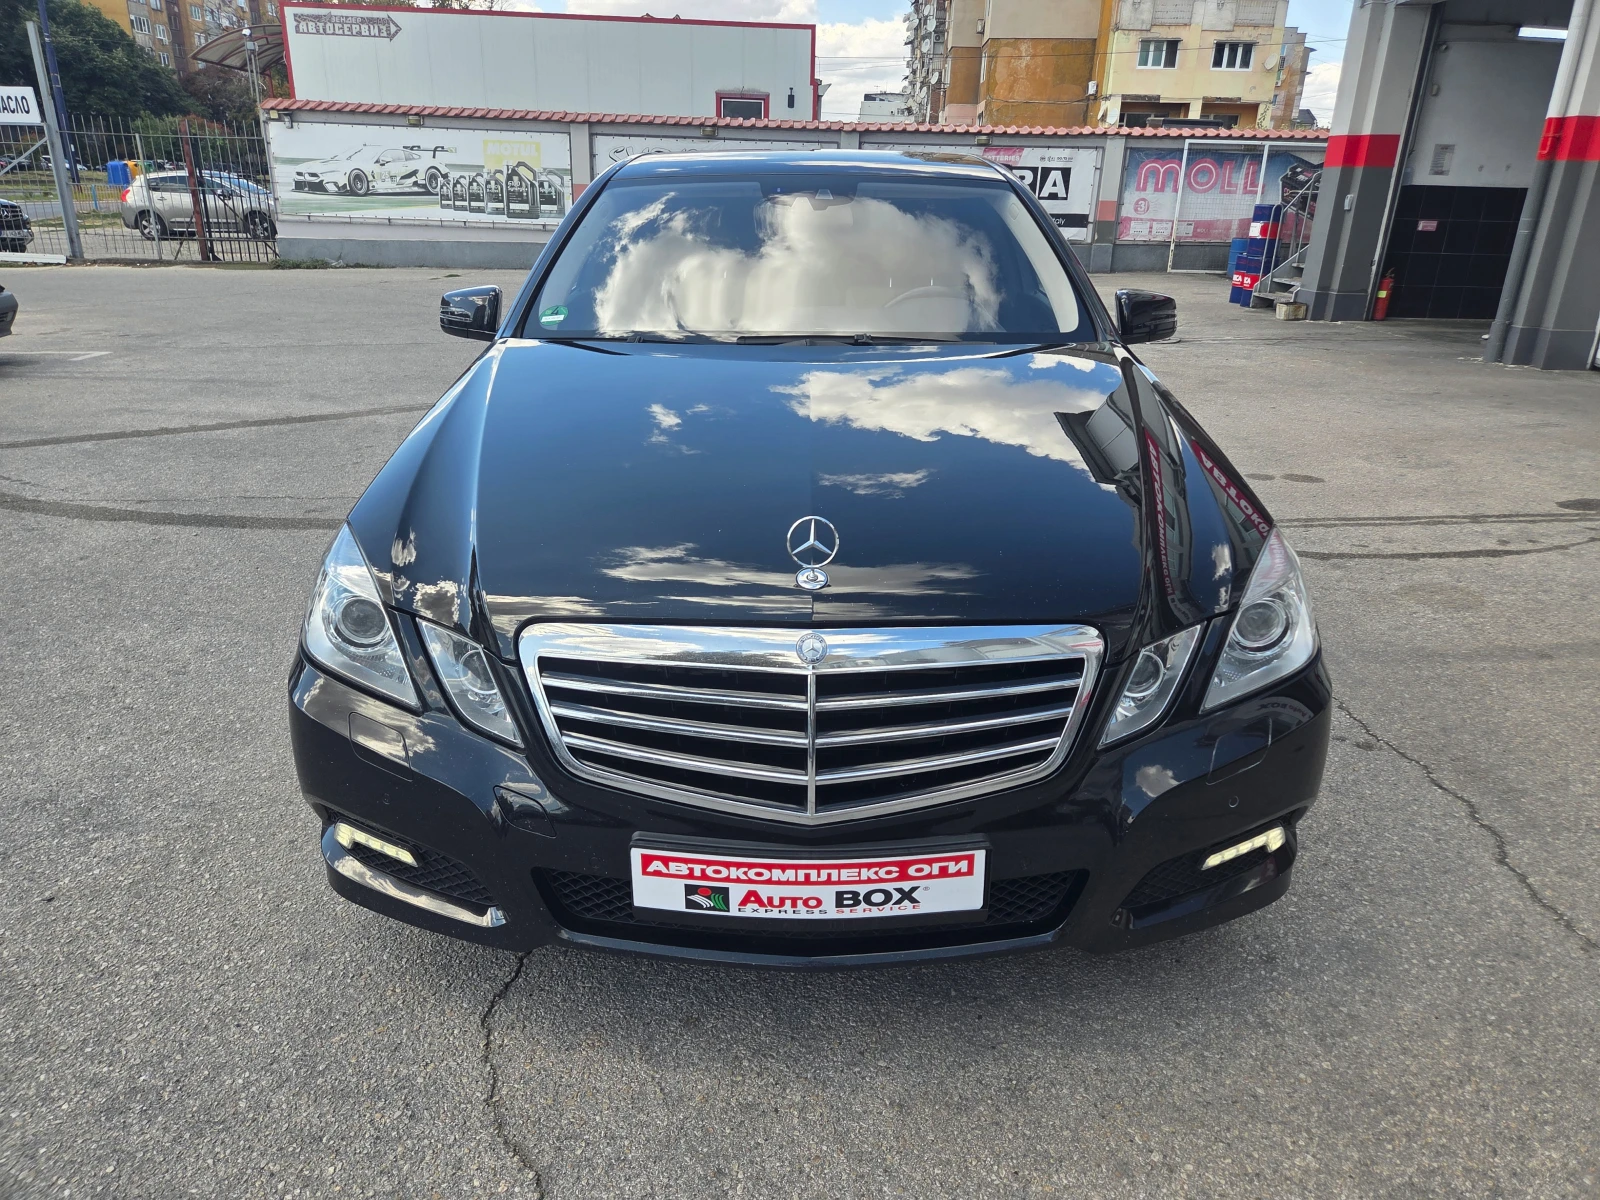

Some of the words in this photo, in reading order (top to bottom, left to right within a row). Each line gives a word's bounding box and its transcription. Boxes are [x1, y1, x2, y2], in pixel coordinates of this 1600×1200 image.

[299, 21, 388, 37] АВТОСЕРВИЗ
[0, 95, 30, 114] АСЛО
[486, 142, 538, 157] MOTUL
[1135, 158, 1265, 194] MOLL
[1052, 217, 1066, 226] taly
[646, 860, 900, 882] АВТОКОМПЛЕКС
[907, 860, 969, 876] ОГИ
[738, 907, 828, 915] EXPRESS
[835, 903, 921, 914] SERVICE
